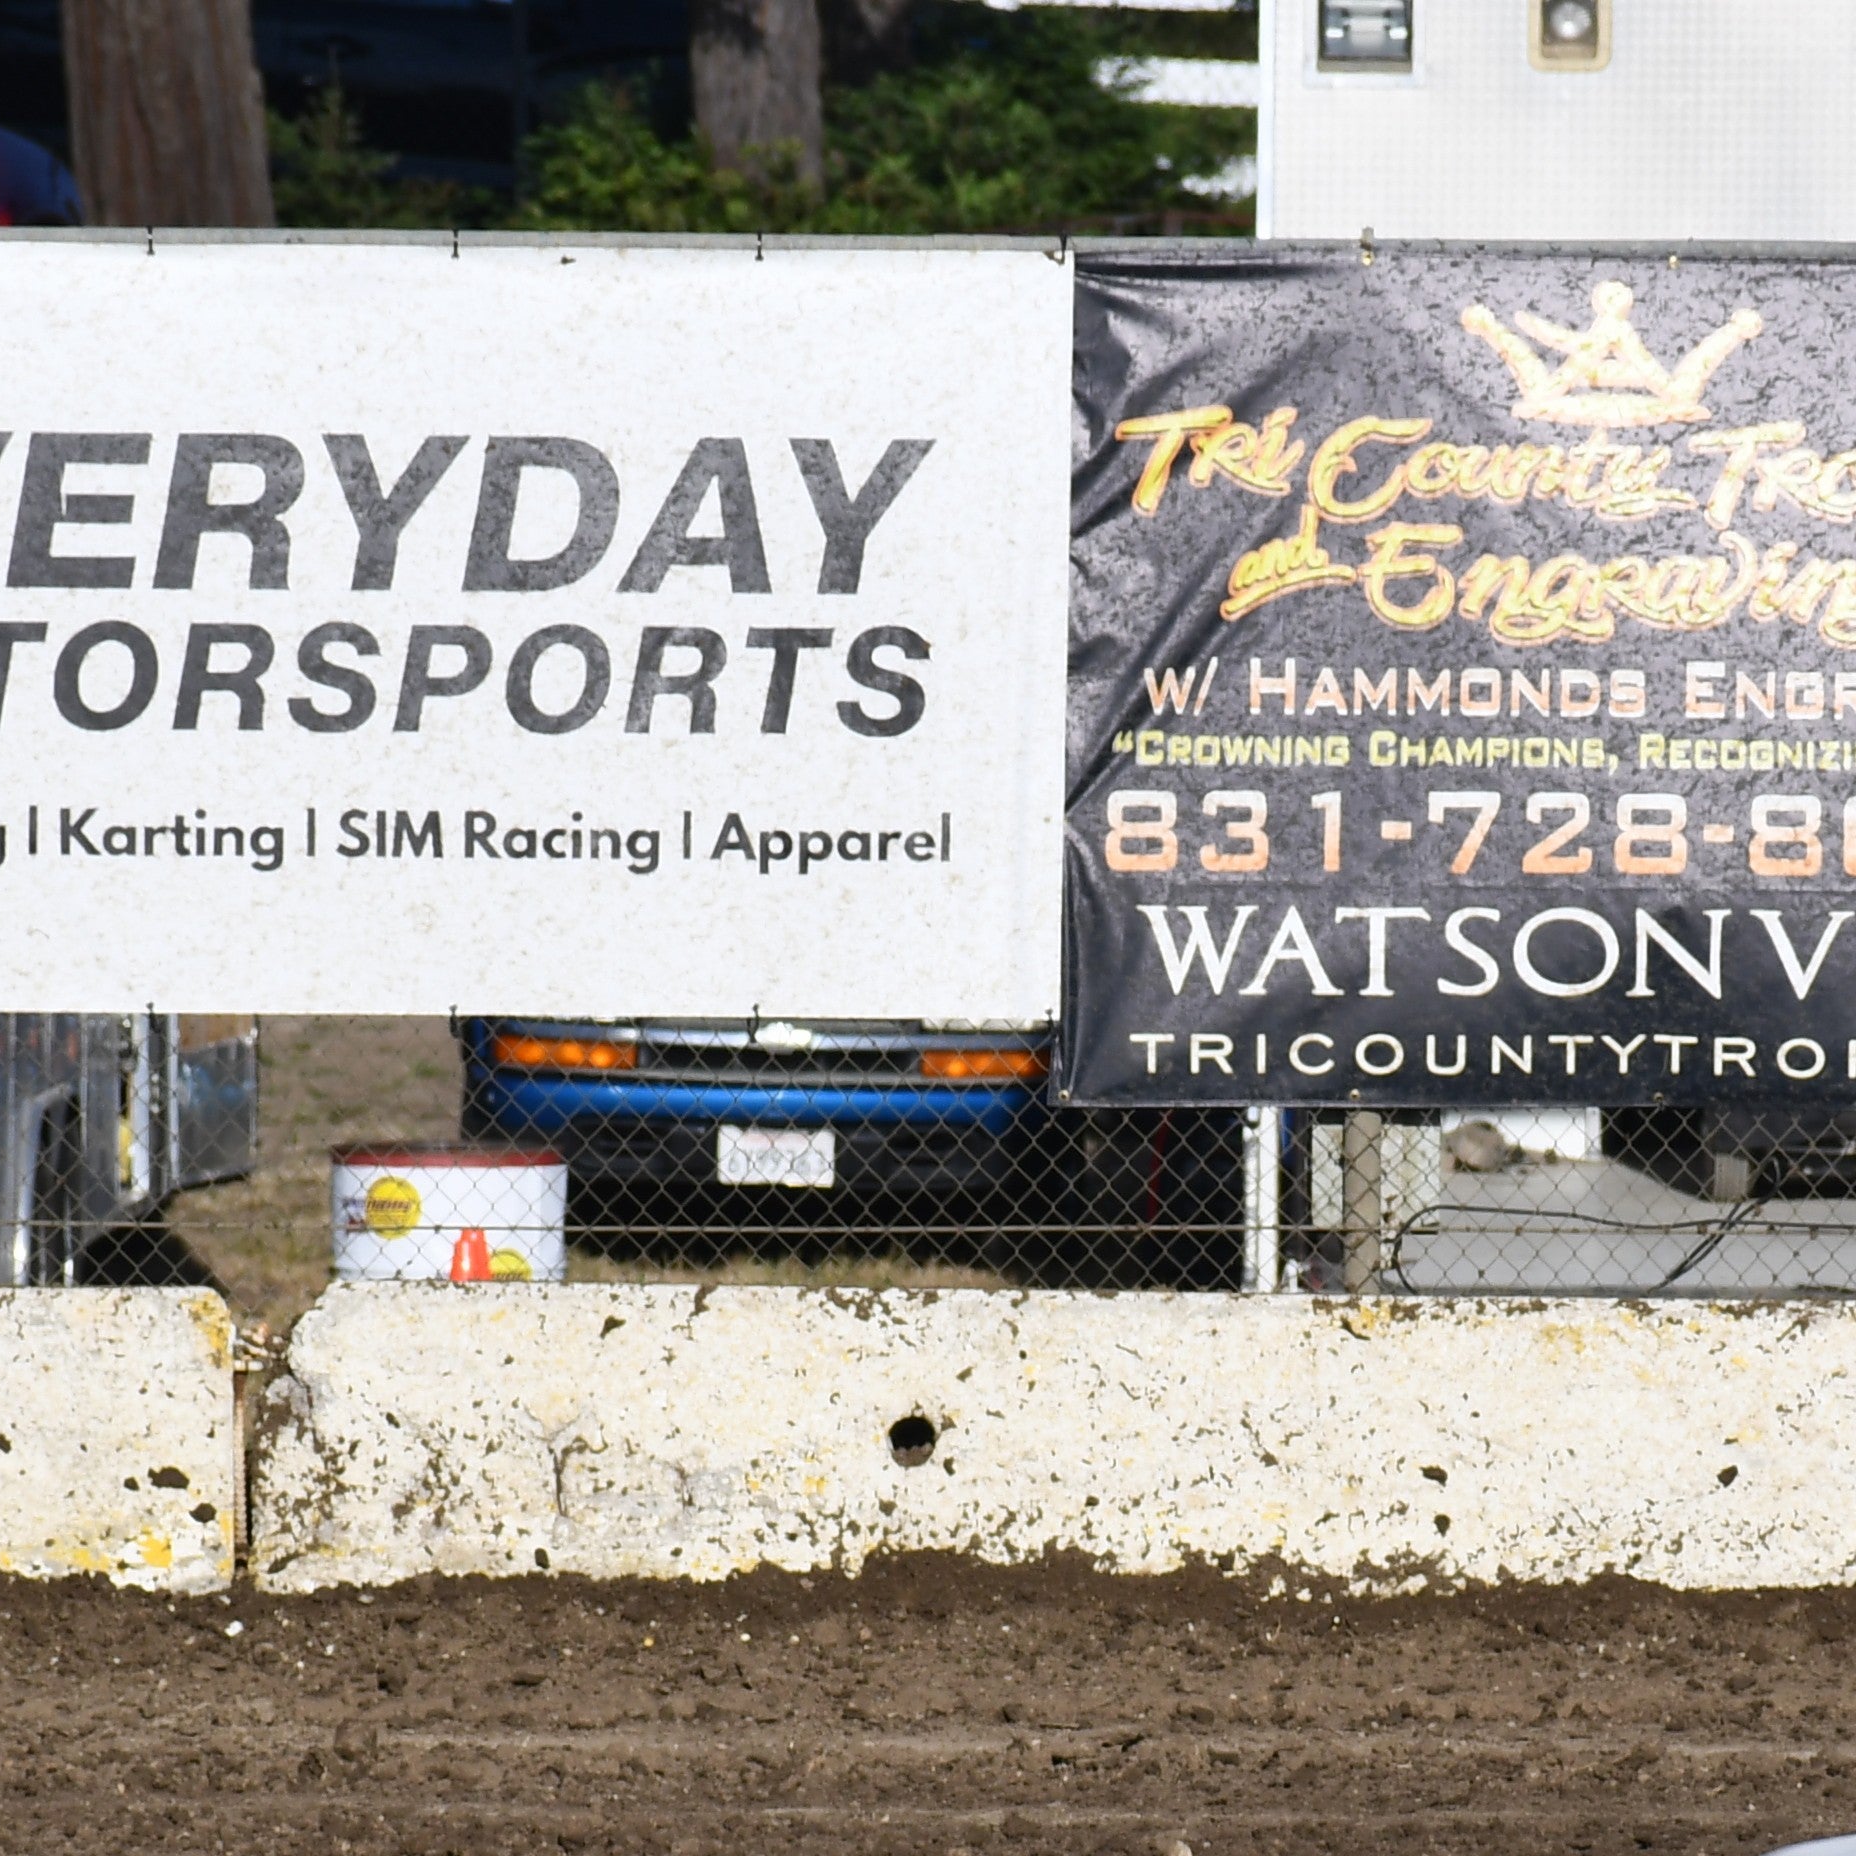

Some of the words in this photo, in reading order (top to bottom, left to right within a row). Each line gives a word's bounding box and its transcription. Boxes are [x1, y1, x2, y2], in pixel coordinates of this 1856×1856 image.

[1306, 416, 1696, 522] County
[1222, 503, 1355, 619] and
[1248, 656, 1647, 719] HAMMONDS
[1367, 729, 1620, 778] CHAMPIONS,
[60, 807, 285, 873] Karting
[337, 808, 444, 859] SIM
[463, 810, 661, 875] Racing
[710, 812, 953, 876] Apparel
